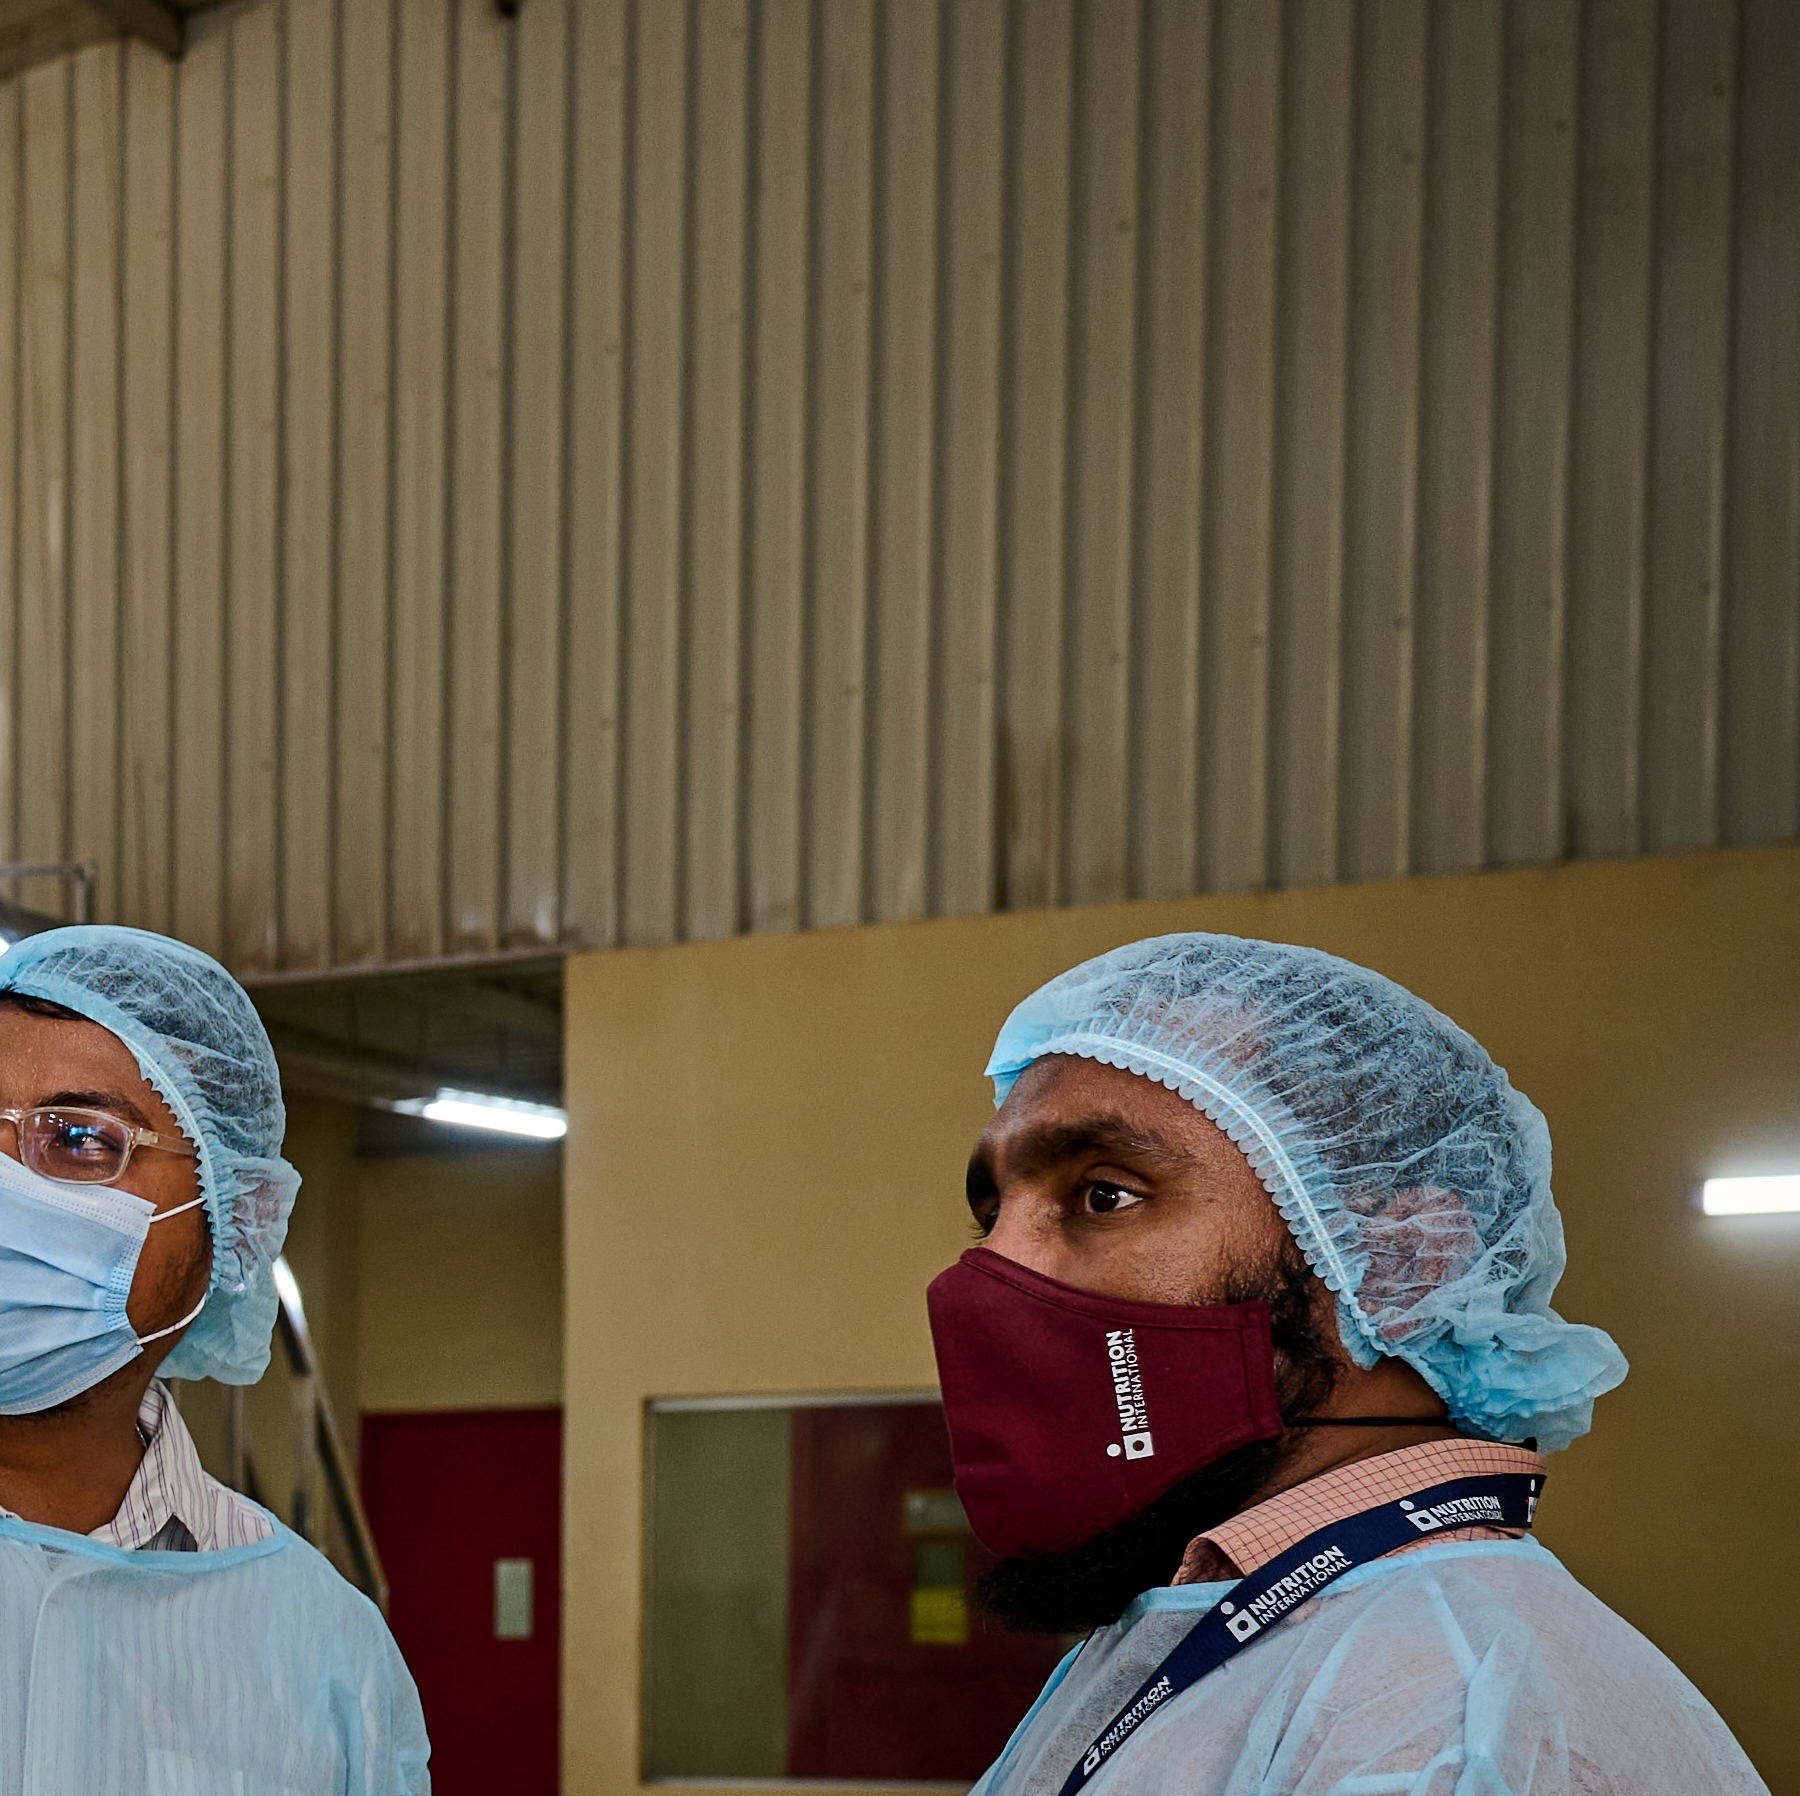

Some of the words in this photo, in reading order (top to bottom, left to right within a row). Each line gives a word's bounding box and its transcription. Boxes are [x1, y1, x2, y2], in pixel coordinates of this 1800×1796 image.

[1105, 1330, 1138, 1432] NUTRITION
[1122, 1328, 1149, 1429] INTERNATIONAL
[1429, 1496, 1501, 1518] NUTRITION
[1248, 1545, 1345, 1616] NUTRITION
[1258, 1558, 1353, 1624] INTERNATIONAL
[1100, 1675, 1171, 1750] NUTRITION
